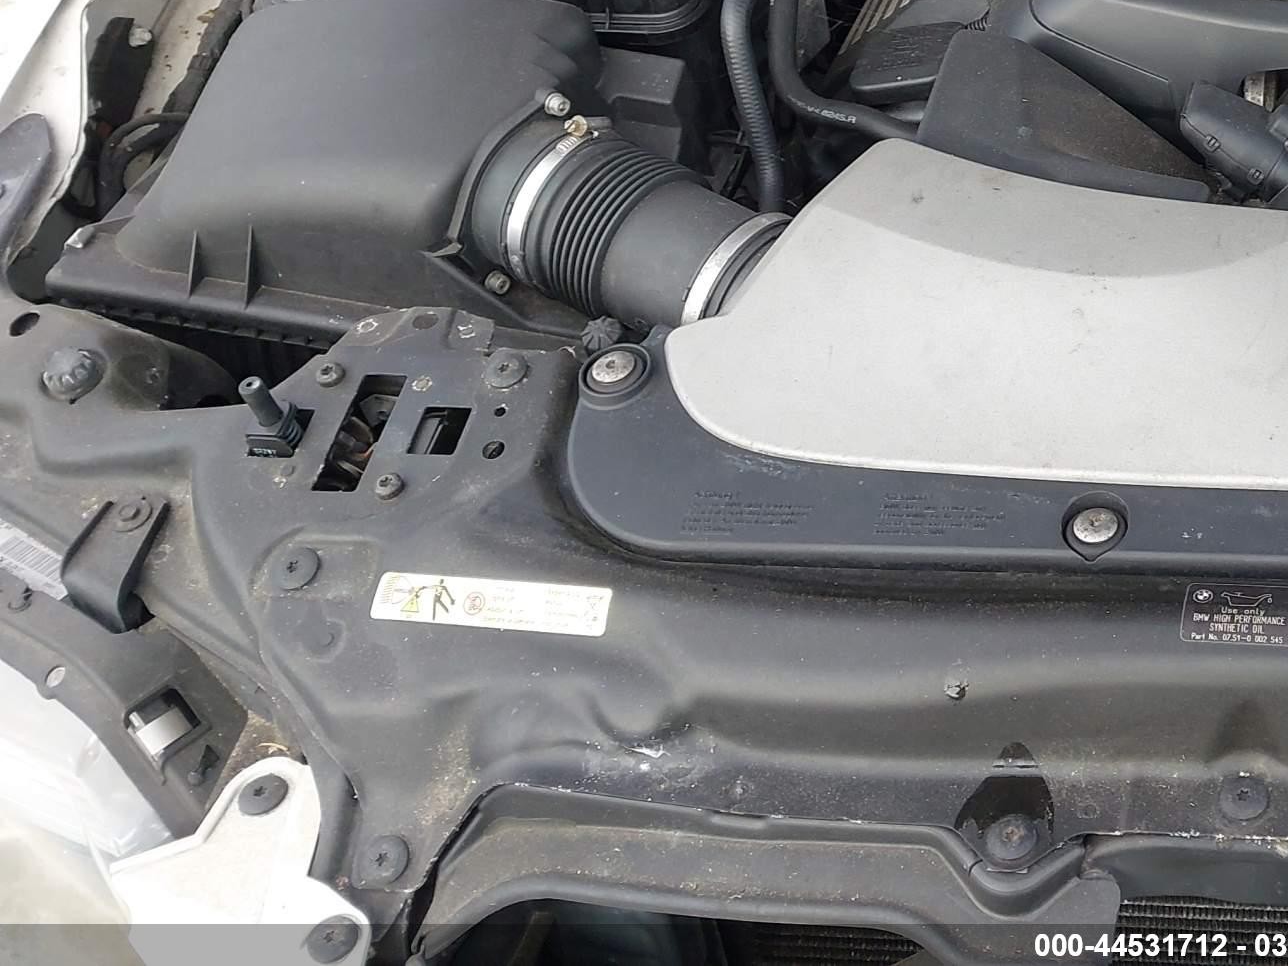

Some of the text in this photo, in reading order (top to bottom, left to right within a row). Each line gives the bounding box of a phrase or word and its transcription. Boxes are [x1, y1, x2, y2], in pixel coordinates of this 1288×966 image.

[1221, 605, 1266, 616] Use only
[1193, 612, 1286, 625] BMW HIGH PERFORMANCE
[1209, 622, 1265, 634] SYNTHETIC OIL
[1191, 632, 1206, 640] Part
